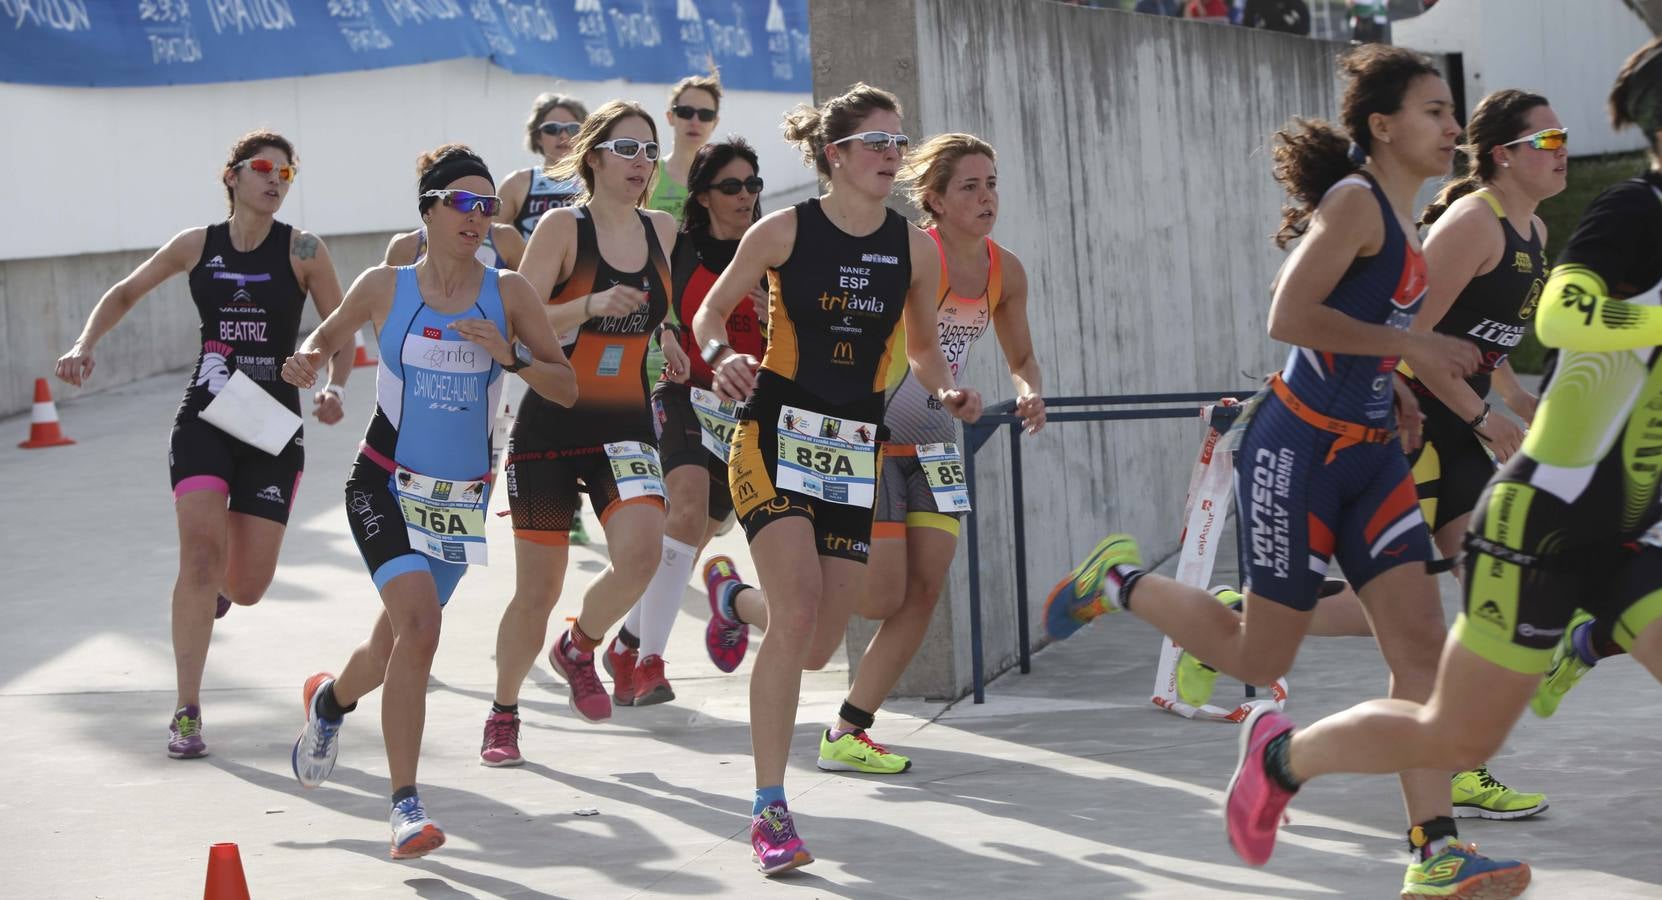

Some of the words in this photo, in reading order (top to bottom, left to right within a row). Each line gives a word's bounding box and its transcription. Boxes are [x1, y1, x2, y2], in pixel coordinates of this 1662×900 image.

[840, 275, 869, 289] ESP
[219, 321, 268, 342] BEATRIZ
[1467, 324, 1524, 347] LUGO
[235, 355, 254, 365] TEAM
[255, 356, 276, 366] SPORT
[796, 447, 854, 476] 83A
[1274, 447, 1295, 498] UNION
[415, 507, 468, 535] 76A
[1251, 448, 1276, 568] COSLADA
[1273, 502, 1290, 578] ATLETICA
